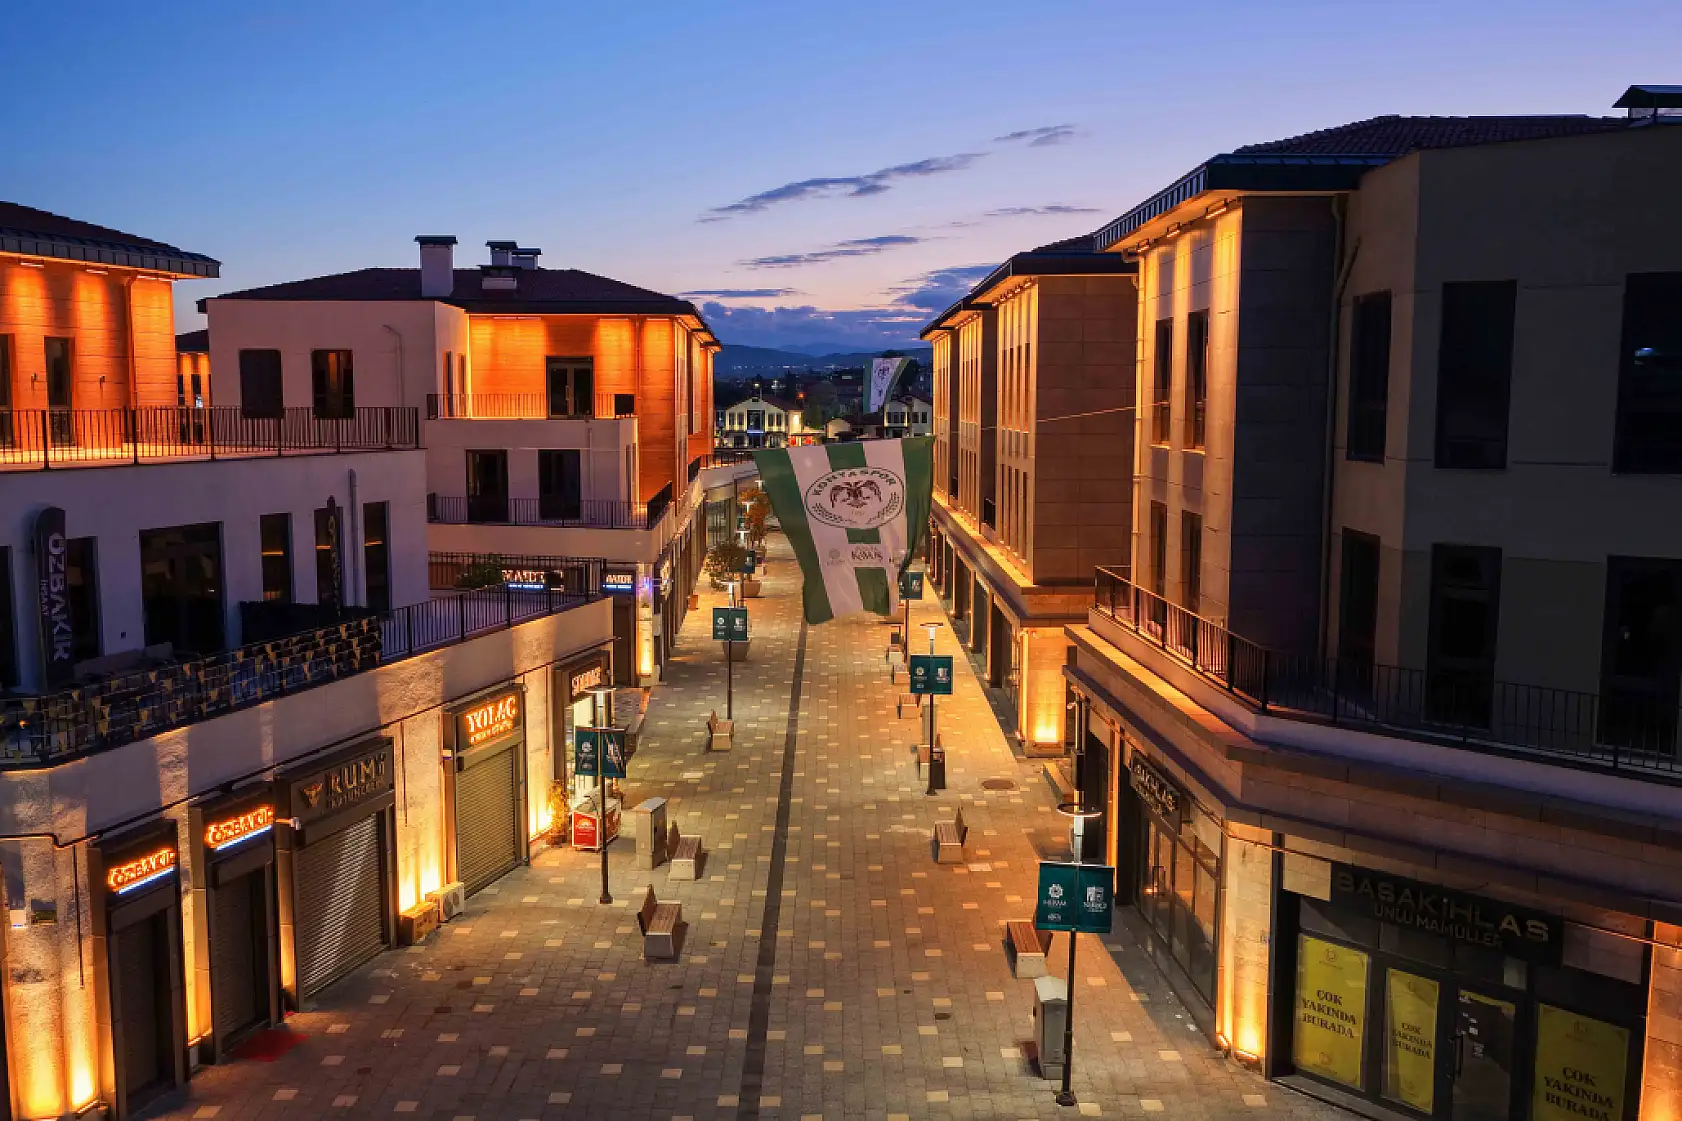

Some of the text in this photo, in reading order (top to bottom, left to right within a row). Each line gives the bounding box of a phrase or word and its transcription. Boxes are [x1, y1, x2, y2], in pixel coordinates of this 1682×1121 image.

[812, 468, 897, 496] KONYASPOR
[1302, 998, 1356, 1025] YAKINDA
[1302, 1012, 1354, 1039] BURADA
[1543, 1075, 1614, 1109] YAKINDA
